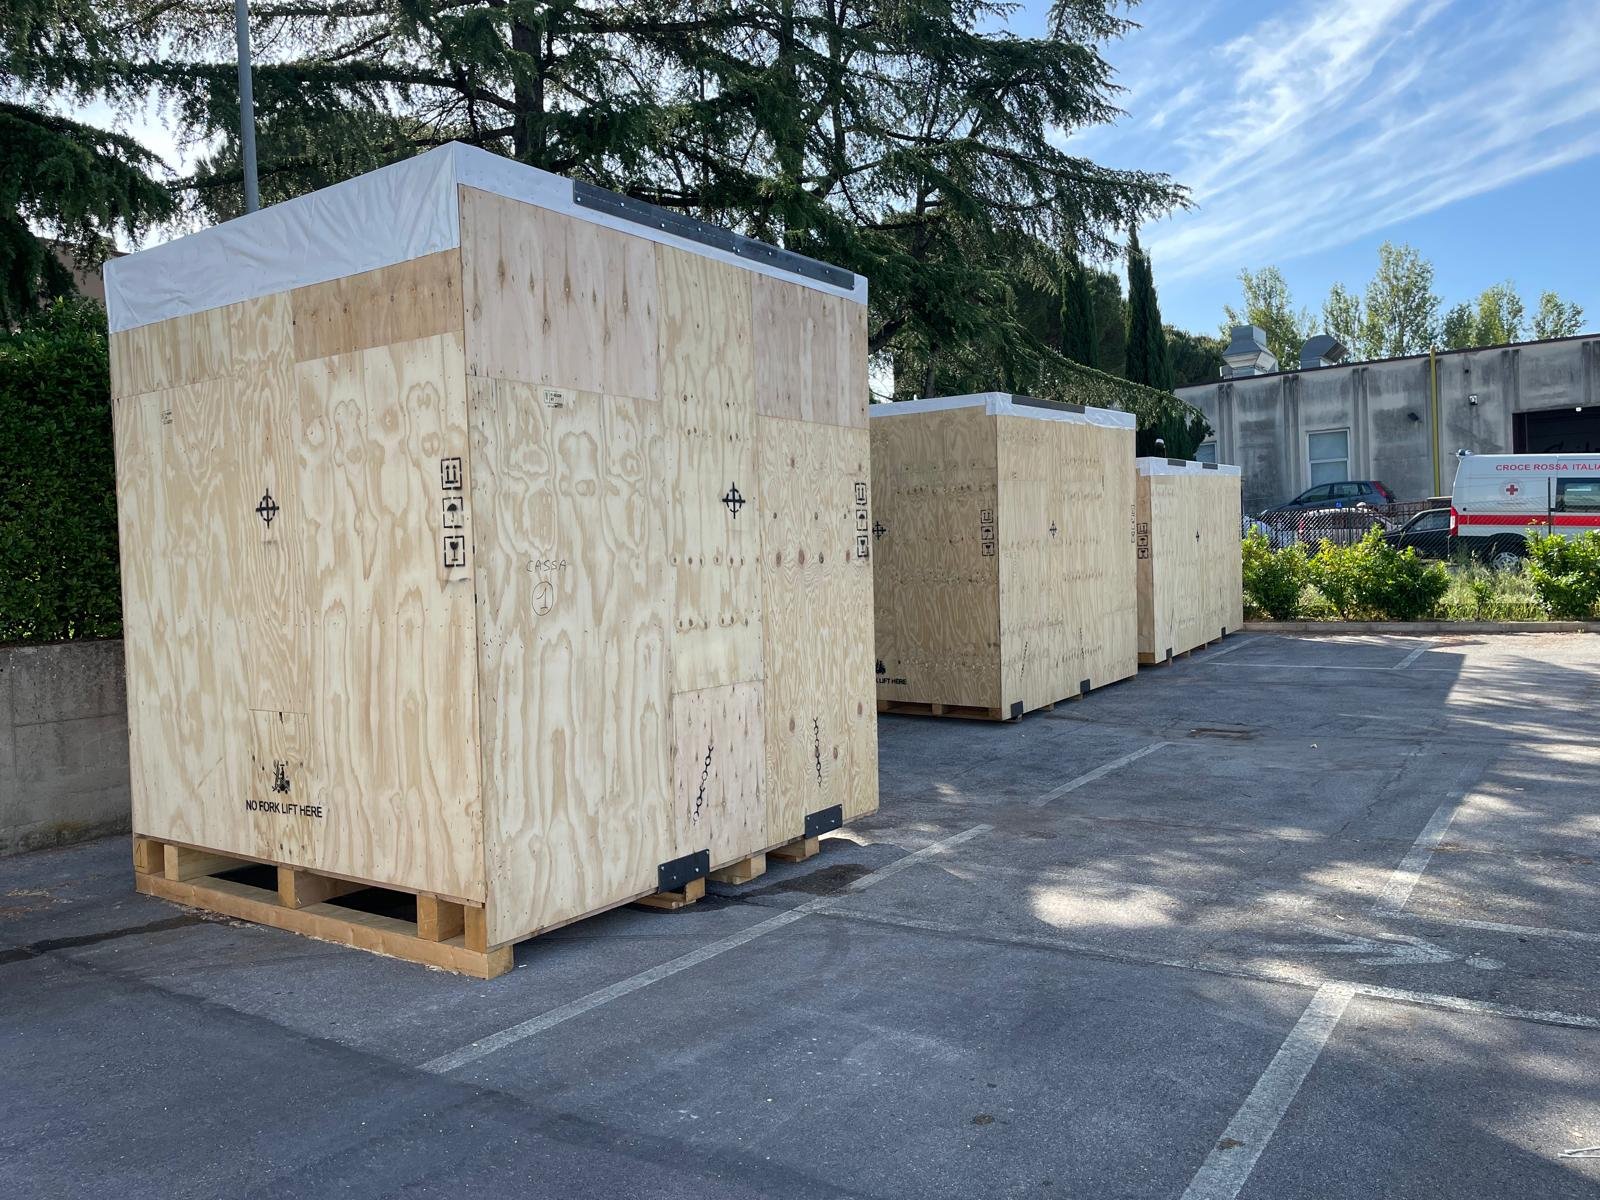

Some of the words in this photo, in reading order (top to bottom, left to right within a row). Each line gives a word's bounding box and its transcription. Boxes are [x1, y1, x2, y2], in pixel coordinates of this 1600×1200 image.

[1533, 463, 1568, 471] ROSSA
[526, 559, 567, 572] CASSA
[245, 799, 258, 811] NO
[259, 801, 281, 814] FORK
[281, 803, 298, 816] LIFT
[299, 805, 323, 818] HERE
